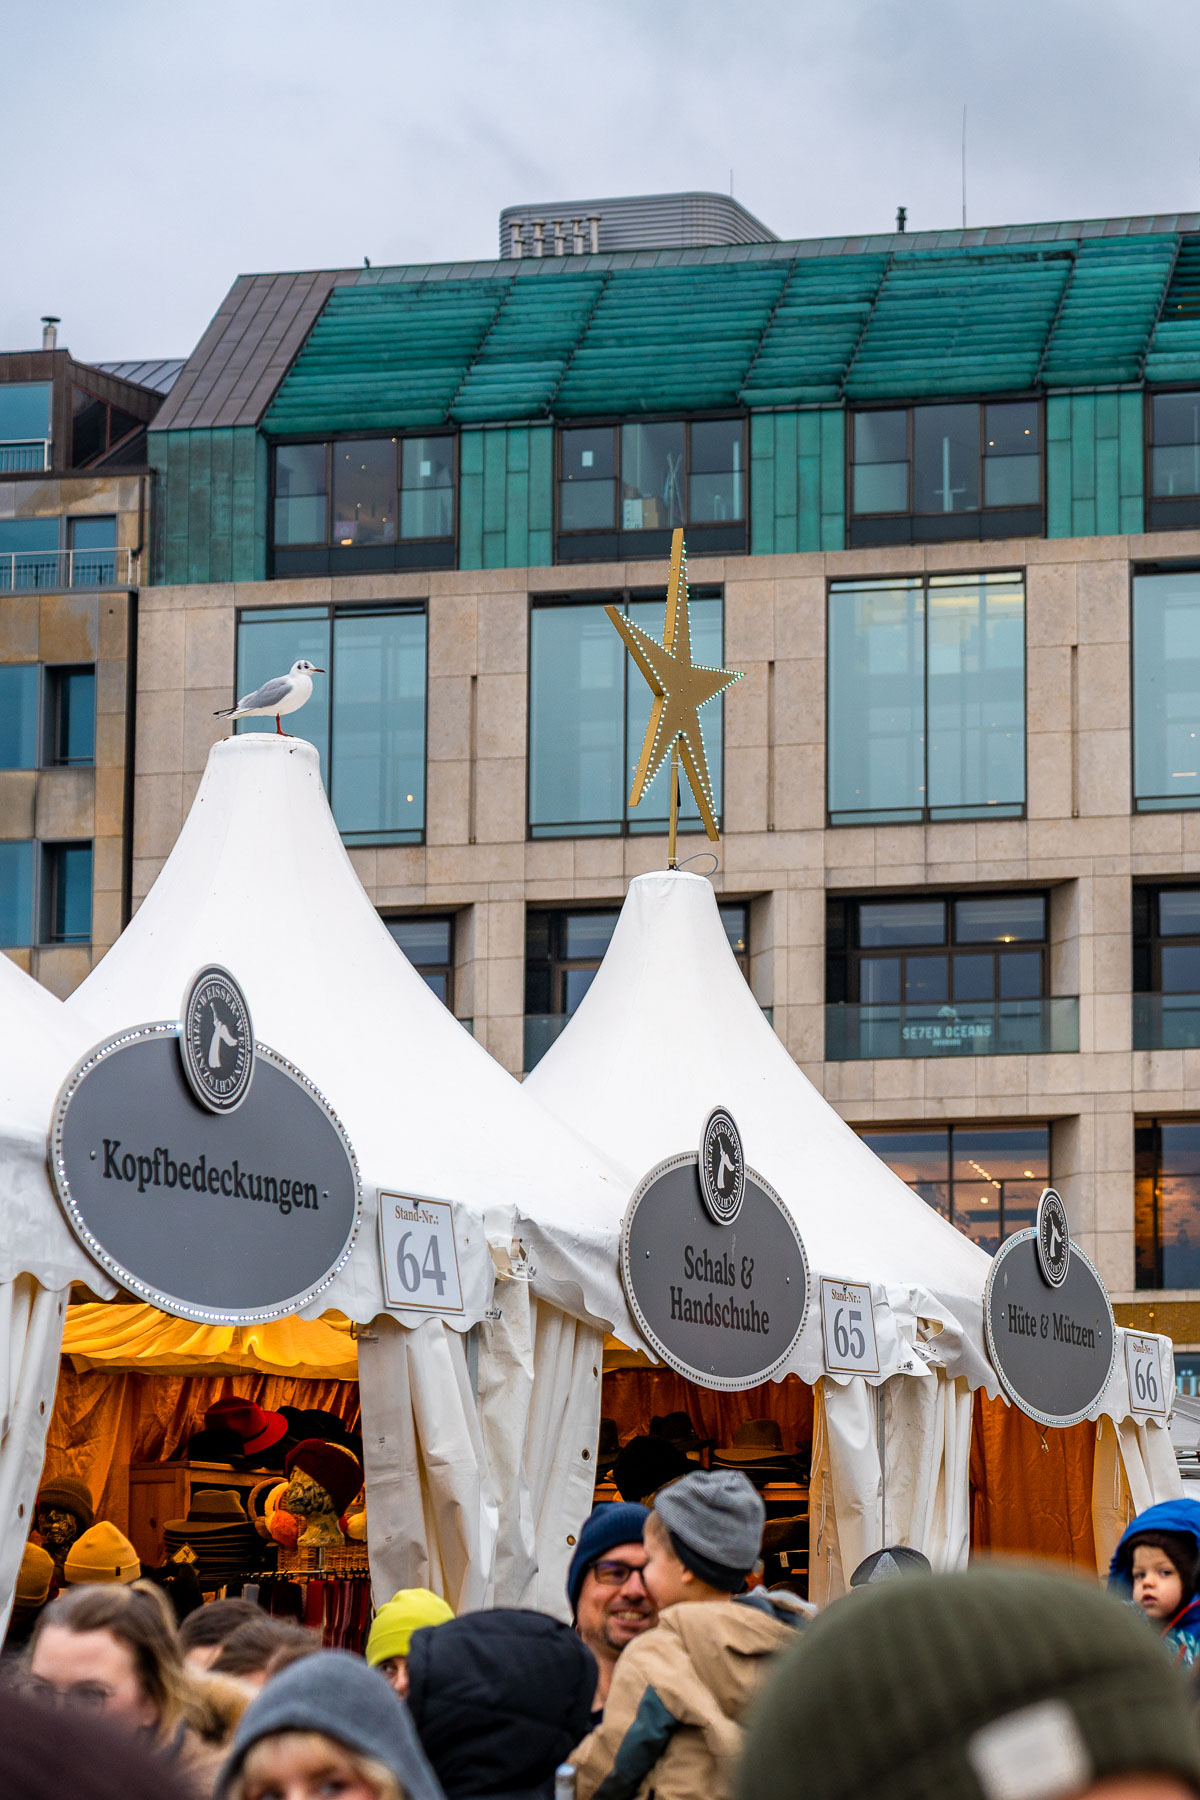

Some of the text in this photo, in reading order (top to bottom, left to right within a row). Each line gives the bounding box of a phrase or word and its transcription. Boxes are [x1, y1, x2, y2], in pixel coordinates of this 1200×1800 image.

[199, 985, 240, 1015] WEISSER
[902, 1024, 992, 1040] SE7EN OCEANS
[103, 1138, 319, 1215] Kopfbedeckungen
[394, 1205, 439, 1225] Stand-Nr.:
[396, 1231, 447, 1296] 64
[684, 1244, 754, 1290] Schals &
[670, 1286, 770, 1335] Handschuhe
[1008, 1304, 1095, 1349] Hüte & Mützen
[834, 1308, 865, 1359] 65
[1135, 1358, 1158, 1403] 66
